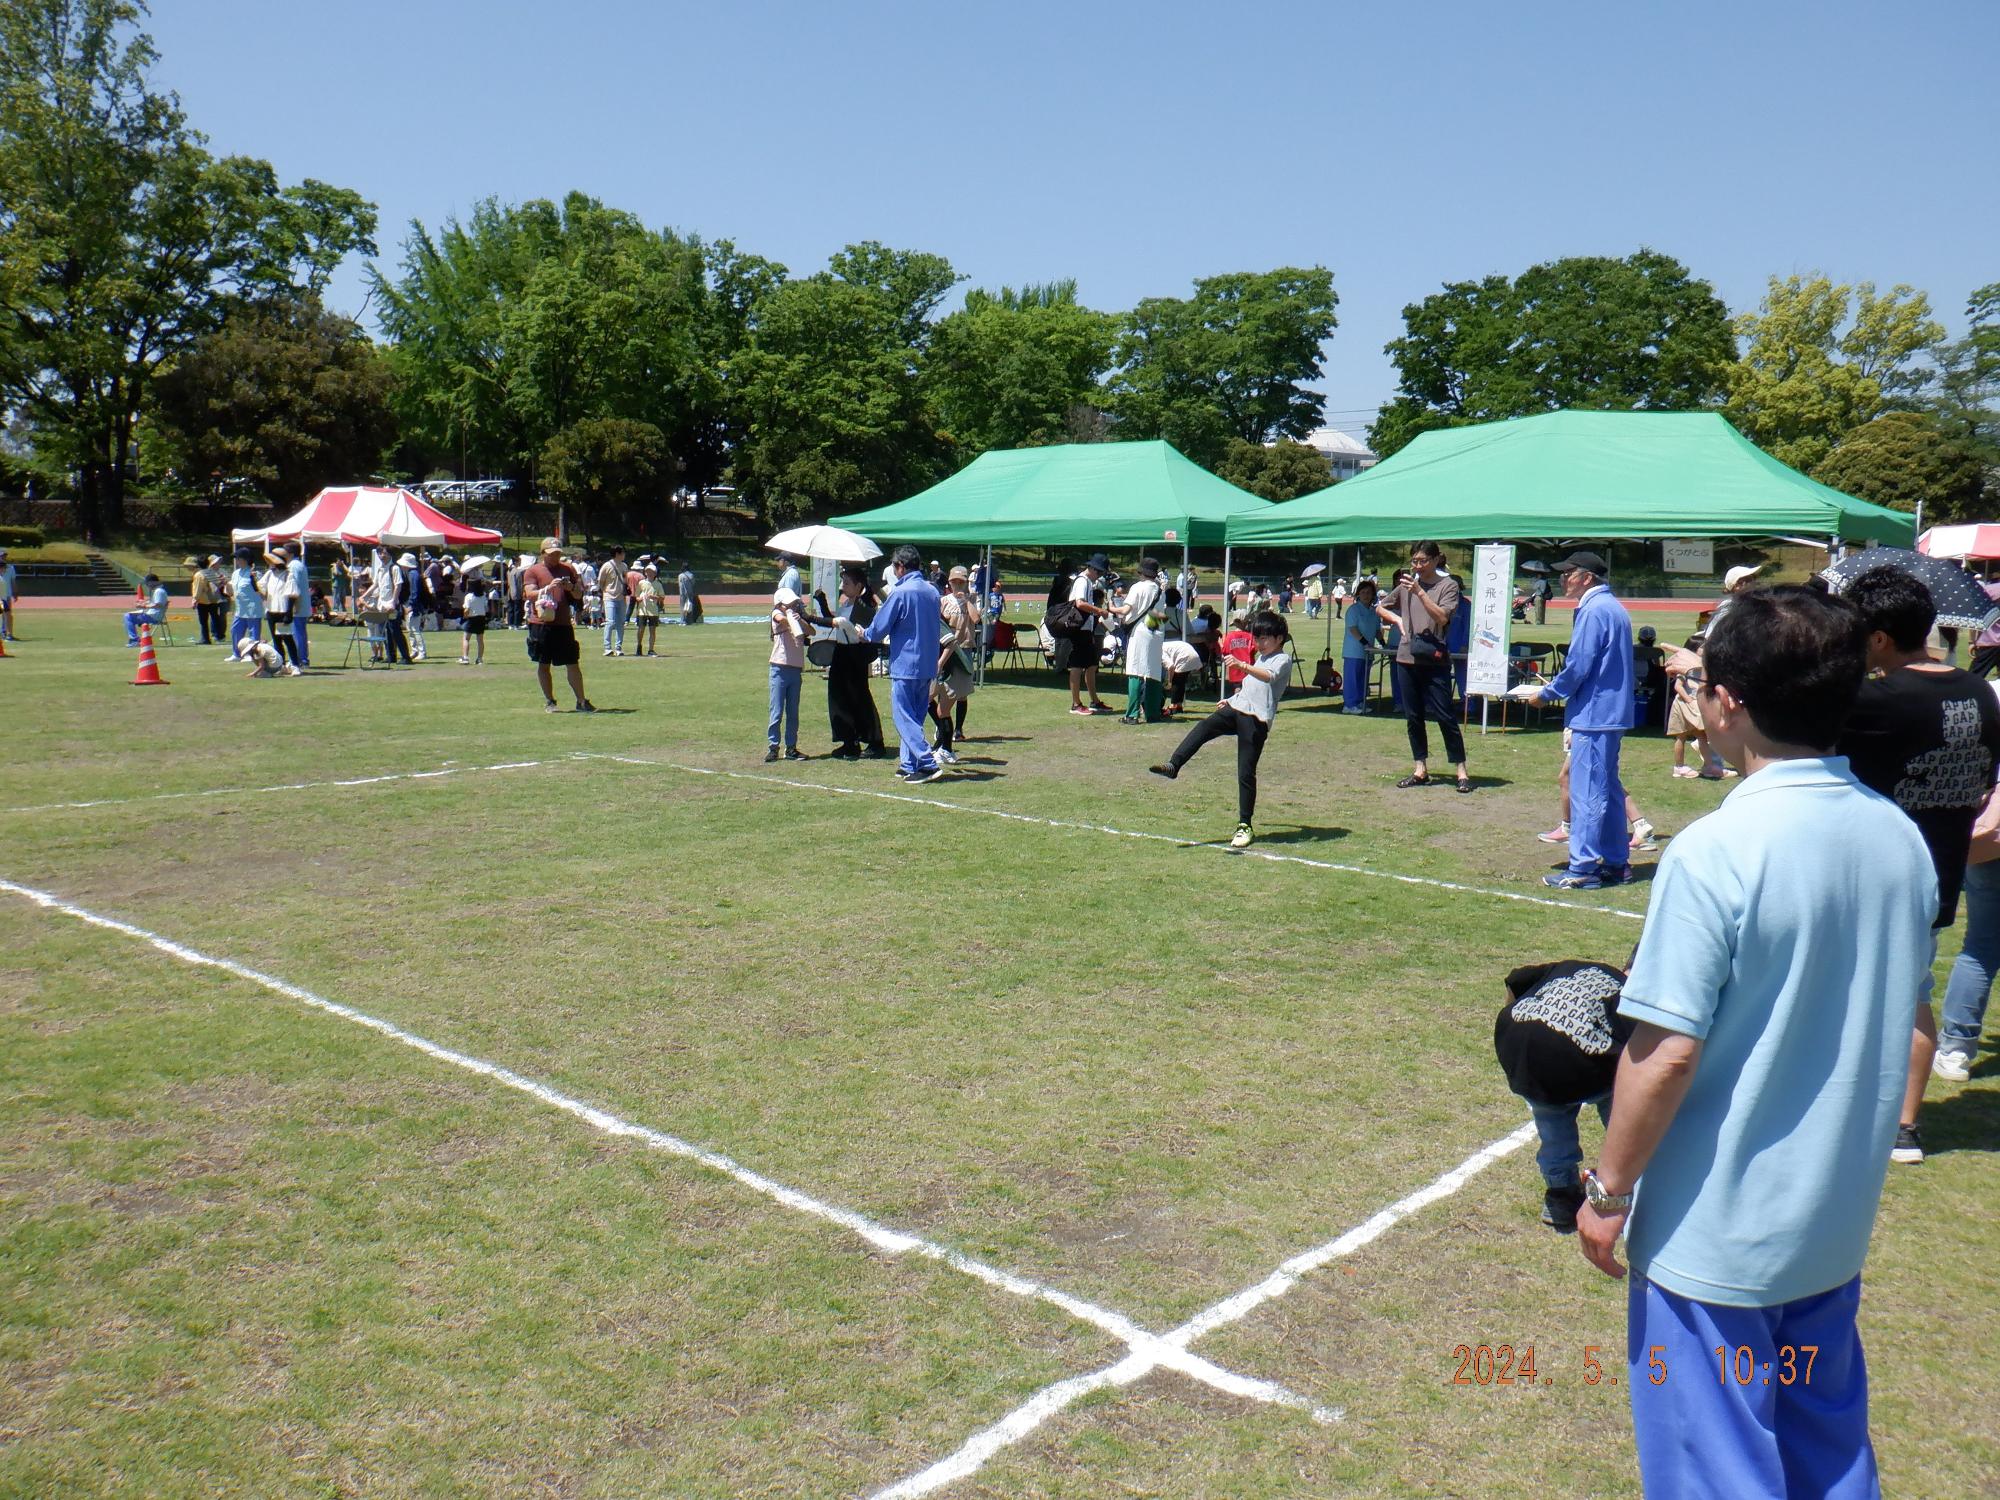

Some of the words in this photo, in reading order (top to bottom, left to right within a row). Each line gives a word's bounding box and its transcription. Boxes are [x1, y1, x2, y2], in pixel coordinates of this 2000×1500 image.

[1485, 554, 1499, 631] くつ飛ばし
[1953, 712, 1974, 724] GAP
[1939, 753, 1962, 765] GAP
[1935, 779, 1959, 789] GAP
[1918, 791, 1944, 802] GAP
[1947, 791, 1970, 802] GAP
[1577, 980, 1600, 995] GAP
[1559, 981, 1581, 994] GAP
[1582, 993, 1602, 1012] GAP
[1562, 993, 1587, 1009] GAP
[1544, 997, 1567, 1011] GAP
[1568, 1009, 1592, 1025] GAP
[1528, 1004, 1549, 1017] GAP
[1550, 1012, 1574, 1030] GAP
[1575, 1026, 1598, 1043] GAP
